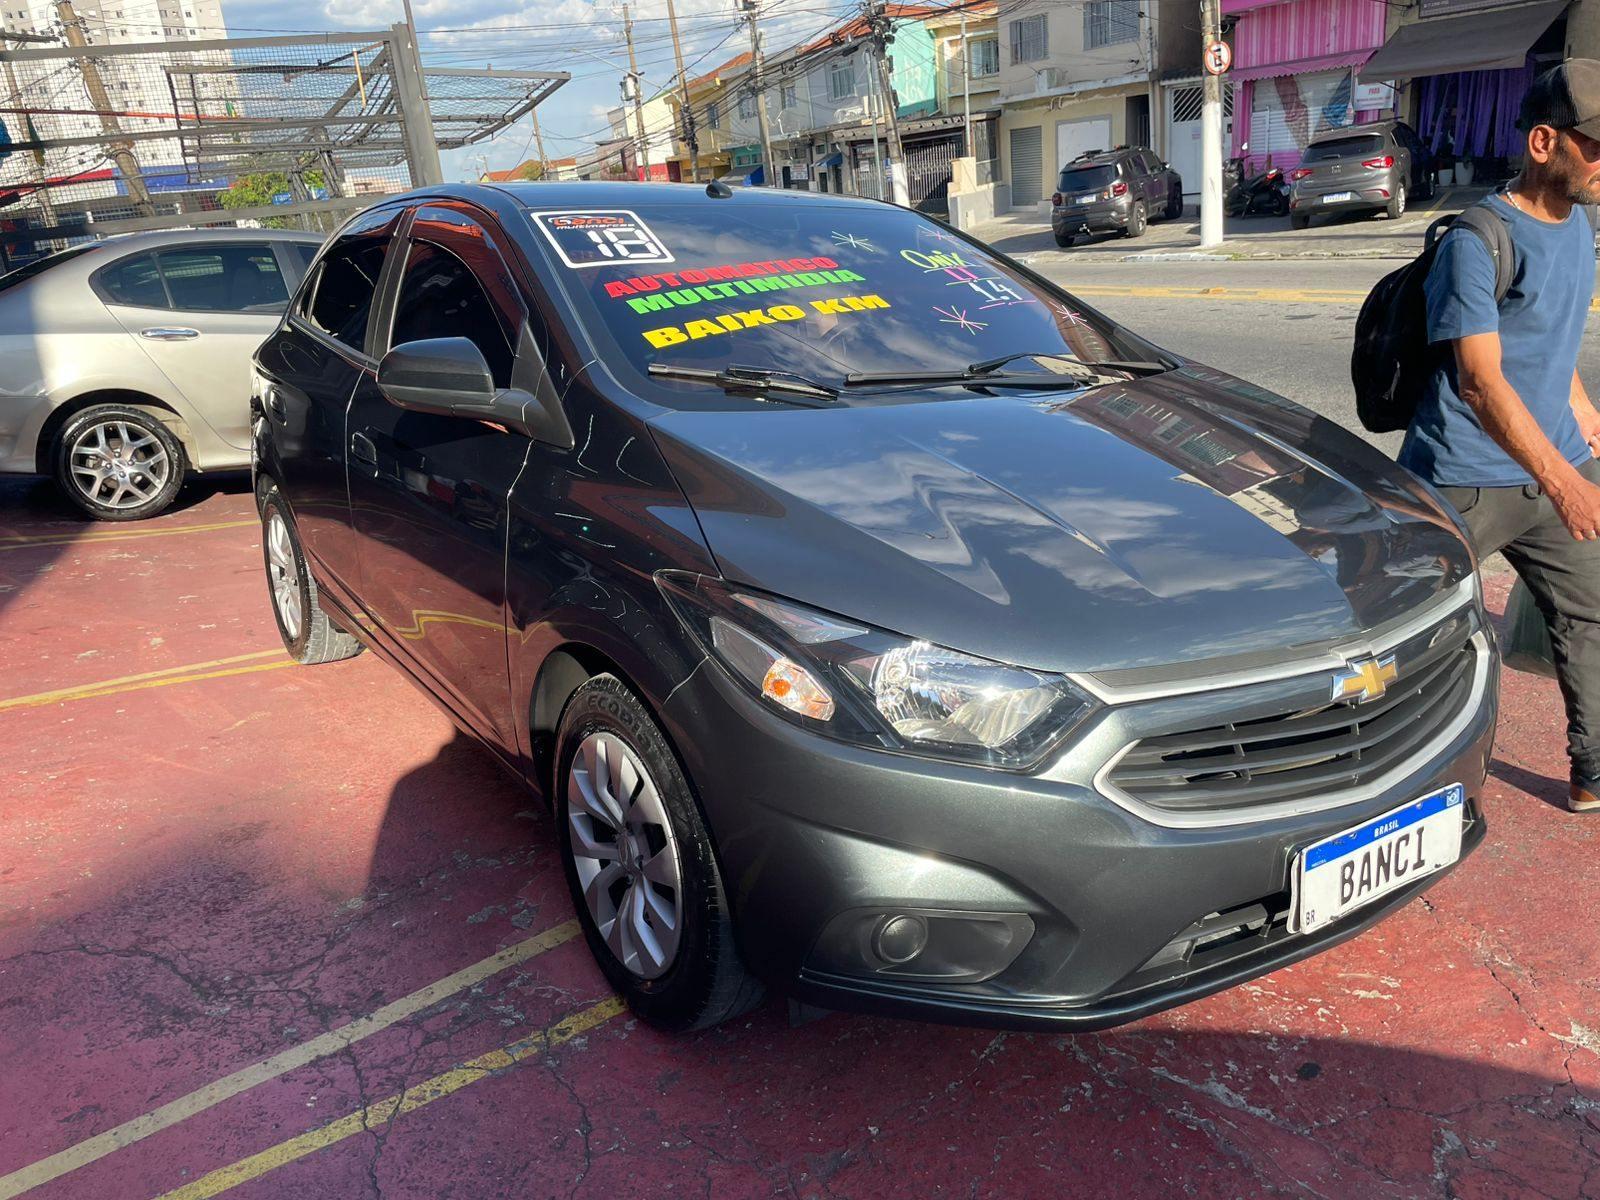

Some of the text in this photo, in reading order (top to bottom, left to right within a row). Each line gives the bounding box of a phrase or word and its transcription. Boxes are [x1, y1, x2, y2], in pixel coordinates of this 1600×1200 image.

[587, 228, 661, 258] 18
[603, 257, 839, 298] AUTOMATICO
[625, 270, 866, 314] MULTIMIDIA
[641, 294, 891, 348] BAIXO KM
[1374, 819, 1399, 838] BRASIL
[1341, 827, 1425, 905] BANCI
[1305, 909, 1316, 926] BR
